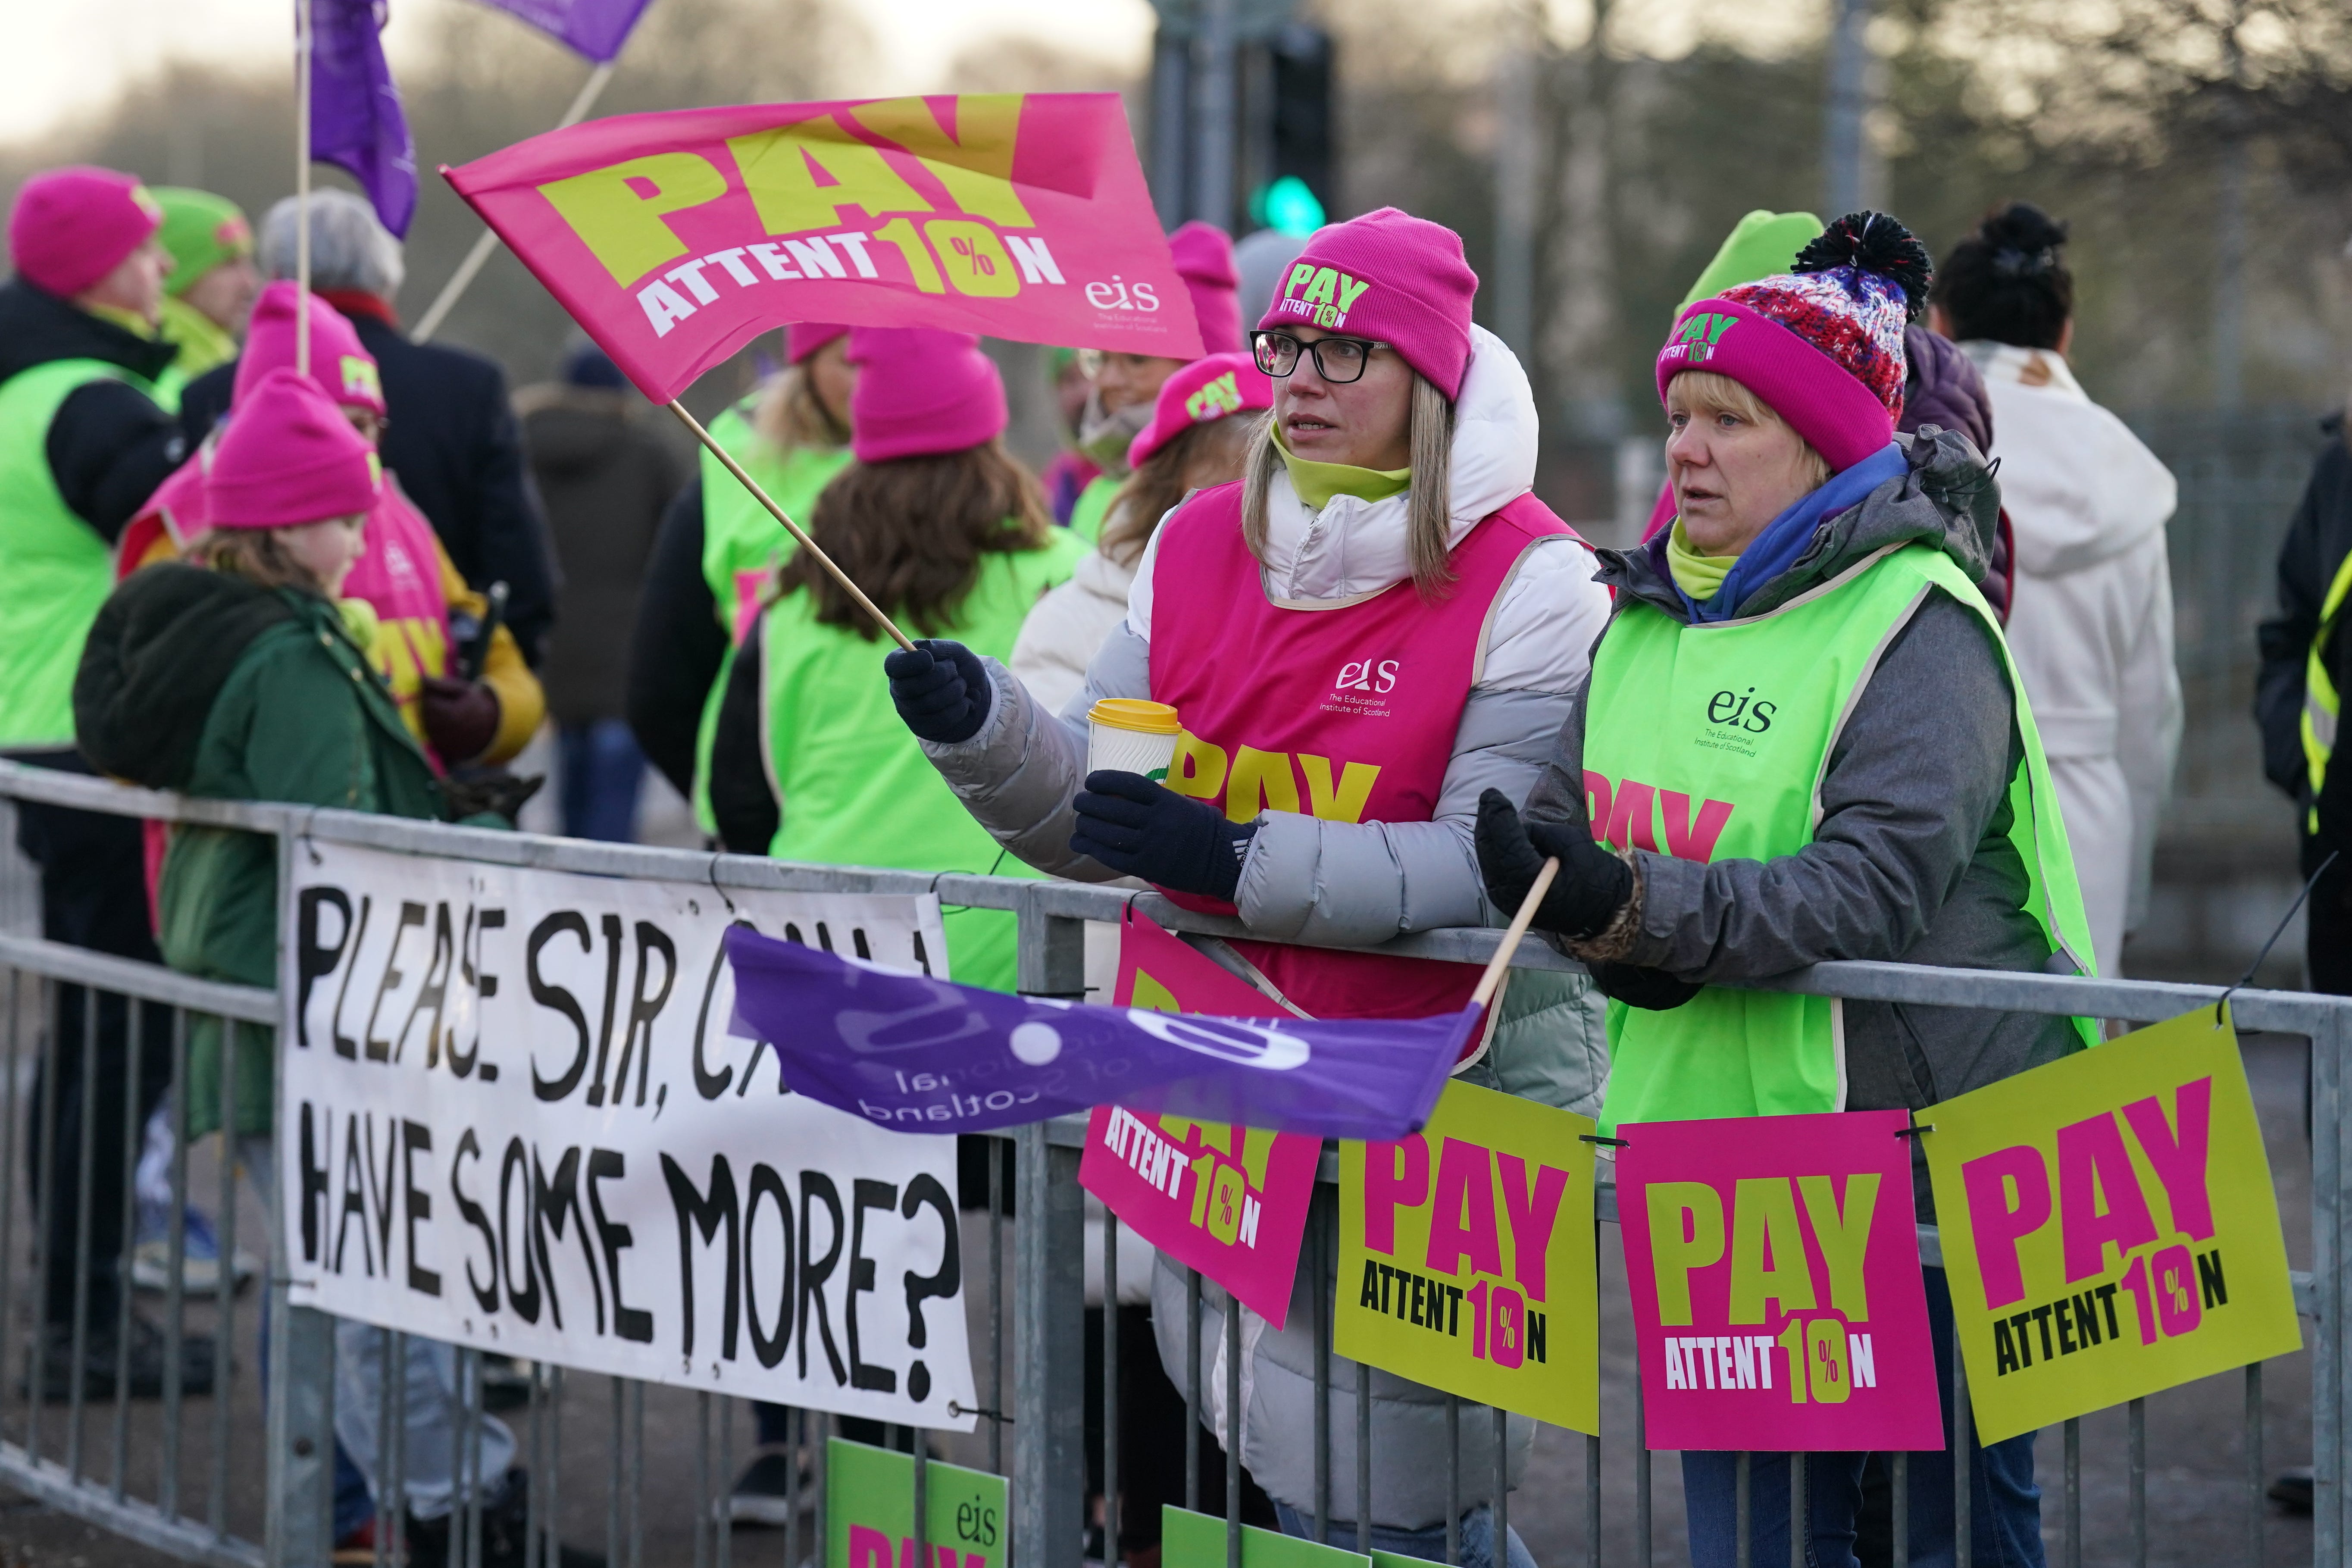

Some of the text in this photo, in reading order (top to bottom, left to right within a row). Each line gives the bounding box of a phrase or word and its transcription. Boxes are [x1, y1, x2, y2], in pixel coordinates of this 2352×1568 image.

[535, 93, 1036, 289] PAY
[1085, 275, 1160, 312] eis
[1285, 263, 1370, 313] PAY
[1668, 313, 1739, 347] PAY
[1329, 693, 1386, 707] The Educational
[1336, 658, 1399, 693] eis
[1320, 703, 1351, 713] Institute
[1363, 707, 1391, 717] Scotland
[1708, 687, 1777, 733] eis
[1694, 737, 1757, 757] Institute of Scotland
[1705, 728, 1754, 746] The Educational
[1164, 729, 1382, 824] PAY
[298, 884, 506, 1081] PLEASE
[527, 909, 677, 1121] SIR,
[1364, 1131, 1569, 1303] PAY
[1961, 1075, 2215, 1311] PAY
[300, 1101, 960, 1402] HAVE SOME MORE?
[1645, 1173, 1882, 1326] PAY
[957, 1494, 996, 1547] eis
